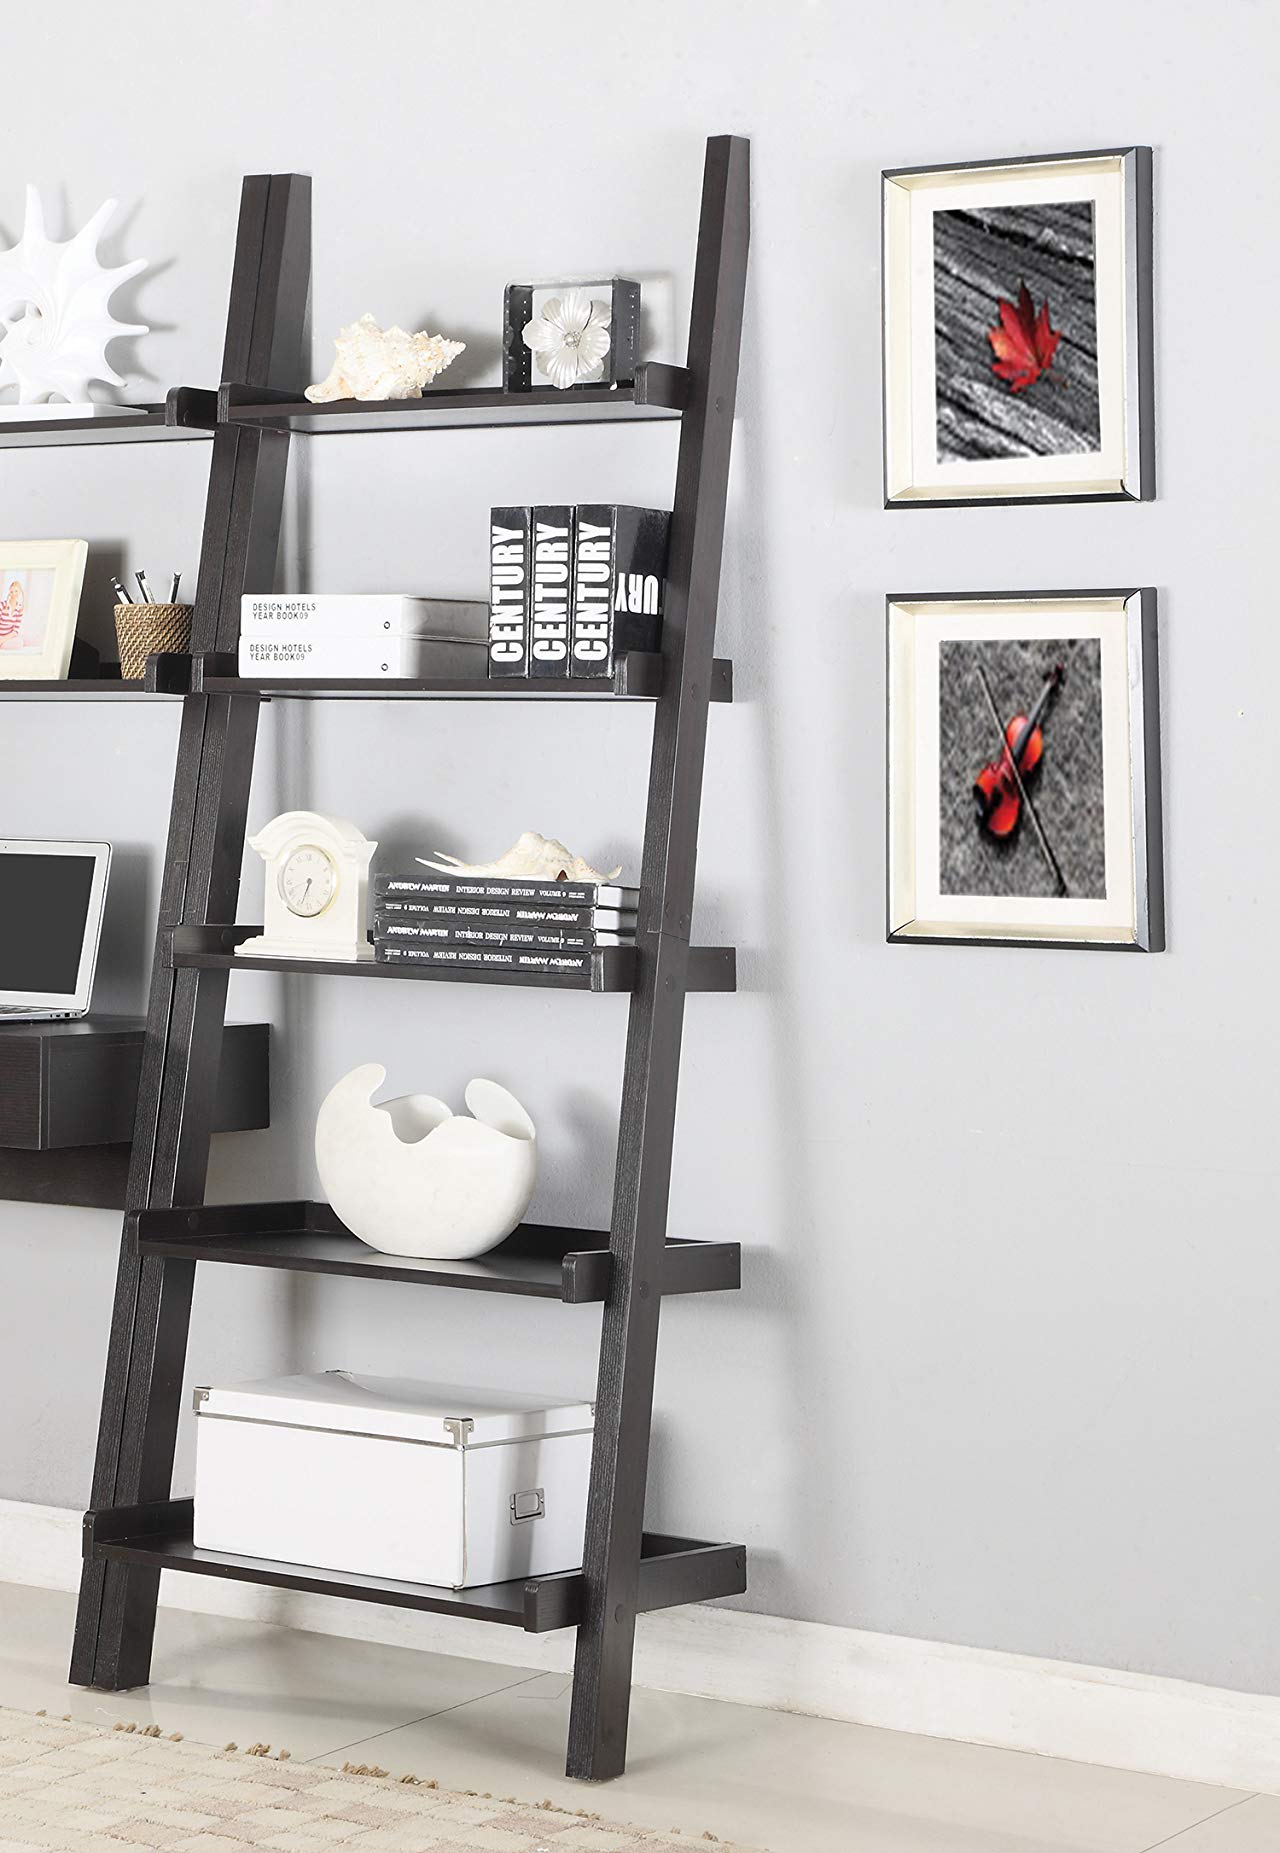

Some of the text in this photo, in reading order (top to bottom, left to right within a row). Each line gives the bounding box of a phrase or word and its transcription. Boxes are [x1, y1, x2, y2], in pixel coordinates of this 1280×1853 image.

[491, 525, 524, 662] CENTURY
[532, 522, 569, 661] CENTURY
[574, 521, 611, 661] CENTURY
[614, 572, 662, 616] URY
[252, 603, 316, 611] DESIGN HOTELS
[252, 612, 274, 620] YEAR
[250, 644, 313, 652] DESIGN HOTELS
[250, 653, 271, 661] YEAR
[455, 885, 485, 894] INTERIOR
[486, 887, 510, 895] DESIGN
[511, 889, 535, 897] REVIEW
[432, 906, 456, 914] REVIEW
[457, 907, 480, 916] DESIGN
[481, 909, 510, 917] INTERIOR
[454, 930, 484, 939] INTERIOR
[485, 932, 508, 940] DESIGN
[509, 934, 534, 942] REVIEW
[433, 951, 456, 960] REVIEW
[458, 953, 481, 961] DESIGN
[483, 954, 512, 962] INTERIOR
